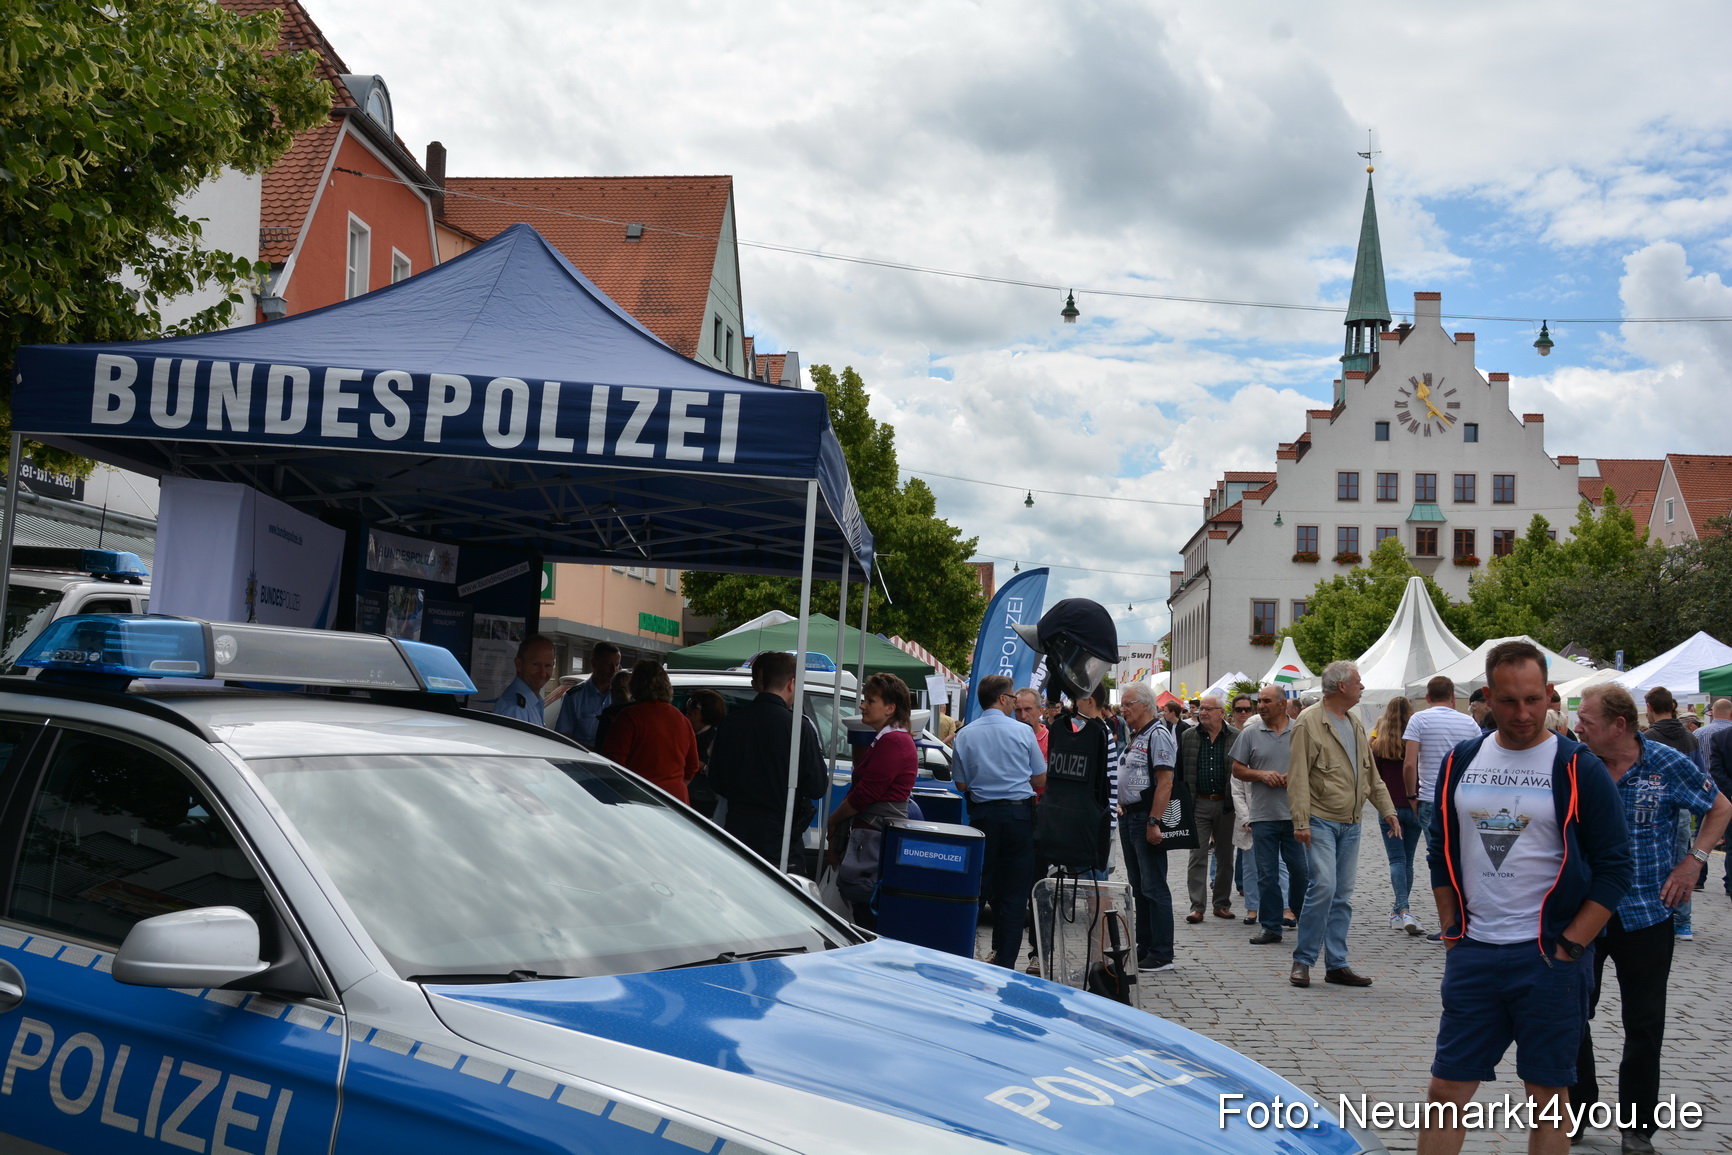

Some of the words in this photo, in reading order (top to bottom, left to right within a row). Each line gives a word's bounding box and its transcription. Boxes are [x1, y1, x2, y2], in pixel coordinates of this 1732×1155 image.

[91, 353, 742, 464] BUNDESPOLIZEI
[460, 563, 528, 594] www.bundespolizei.de
[998, 597, 1024, 678] SPOLIZEI
[1049, 752, 1088, 777] POLIZEI
[1461, 773, 1488, 785] LET'S
[1490, 775, 1518, 786] RUN
[1520, 776, 1552, 788] AWA
[1161, 829, 1191, 839] BERPFALZ
[903, 848, 962, 863] BUNDESPOLIZEI
[1, 1016, 294, 1155] POLIZEI
[984, 1049, 1228, 1131] POLIZEI
